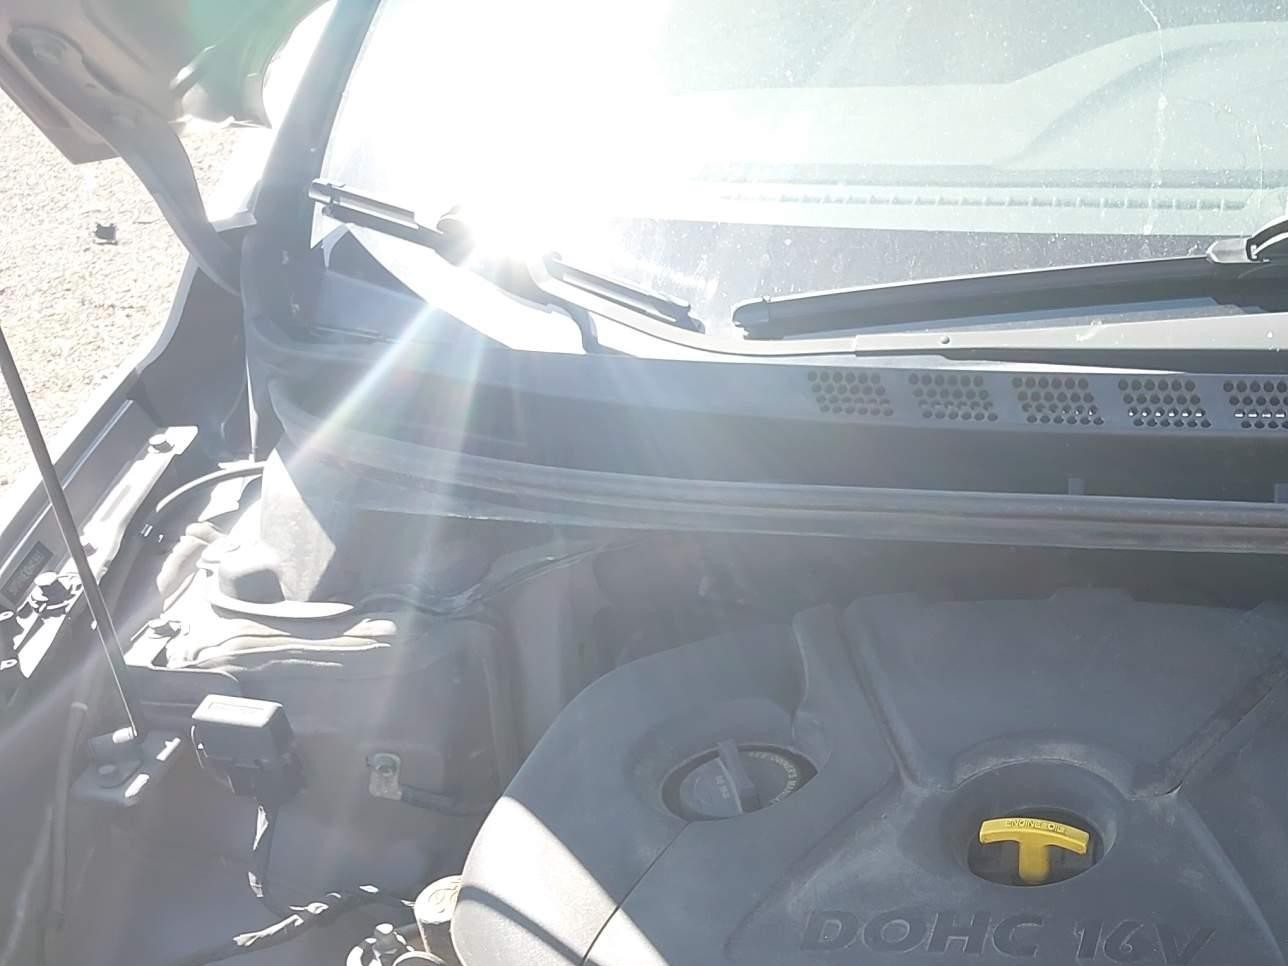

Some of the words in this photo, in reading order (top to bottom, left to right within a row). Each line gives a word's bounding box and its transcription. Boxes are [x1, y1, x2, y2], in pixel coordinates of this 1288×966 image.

[1047, 823, 1065, 833] OIL
[801, 910, 1044, 958] DOHC
[1074, 919, 1217, 965] 16V
